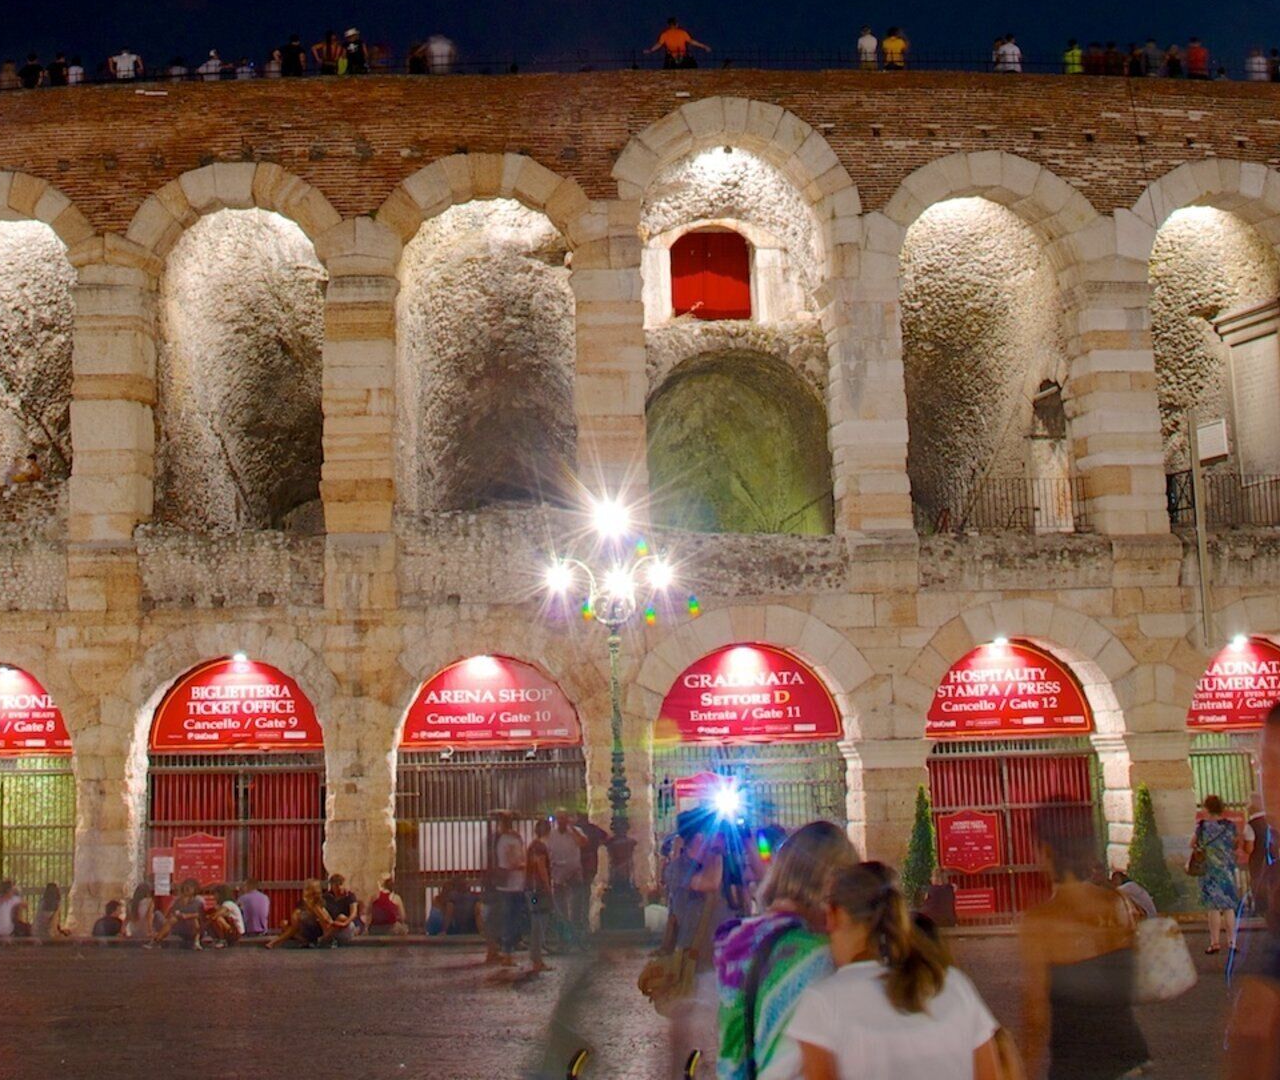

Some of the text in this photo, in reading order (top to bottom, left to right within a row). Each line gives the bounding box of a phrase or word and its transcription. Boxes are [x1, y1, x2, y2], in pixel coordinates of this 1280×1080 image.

[949, 668, 1047, 683] HOSPITALITY
[191, 684, 291, 699] BIGLIETTERIA
[424, 688, 552, 704] ARENA SHOP
[773, 690, 790, 704] D
[937, 681, 1061, 698] STAMPA / PRESS
[187, 700, 295, 715] TICKET OFFICE
[941, 697, 1057, 712] Cancello / Gate 12
[1192, 700, 1233, 710] Entrata
[1246, 698, 1274, 708] Gate
[426, 711, 551, 724] Cancello / Gate 10
[690, 706, 801, 721] Entrata / Gate 11
[3, 722, 11, 733] /
[14, 722, 44, 732] Gate
[46, 721, 55, 732] 8
[183, 717, 298, 730] Cancello / Gate 9
